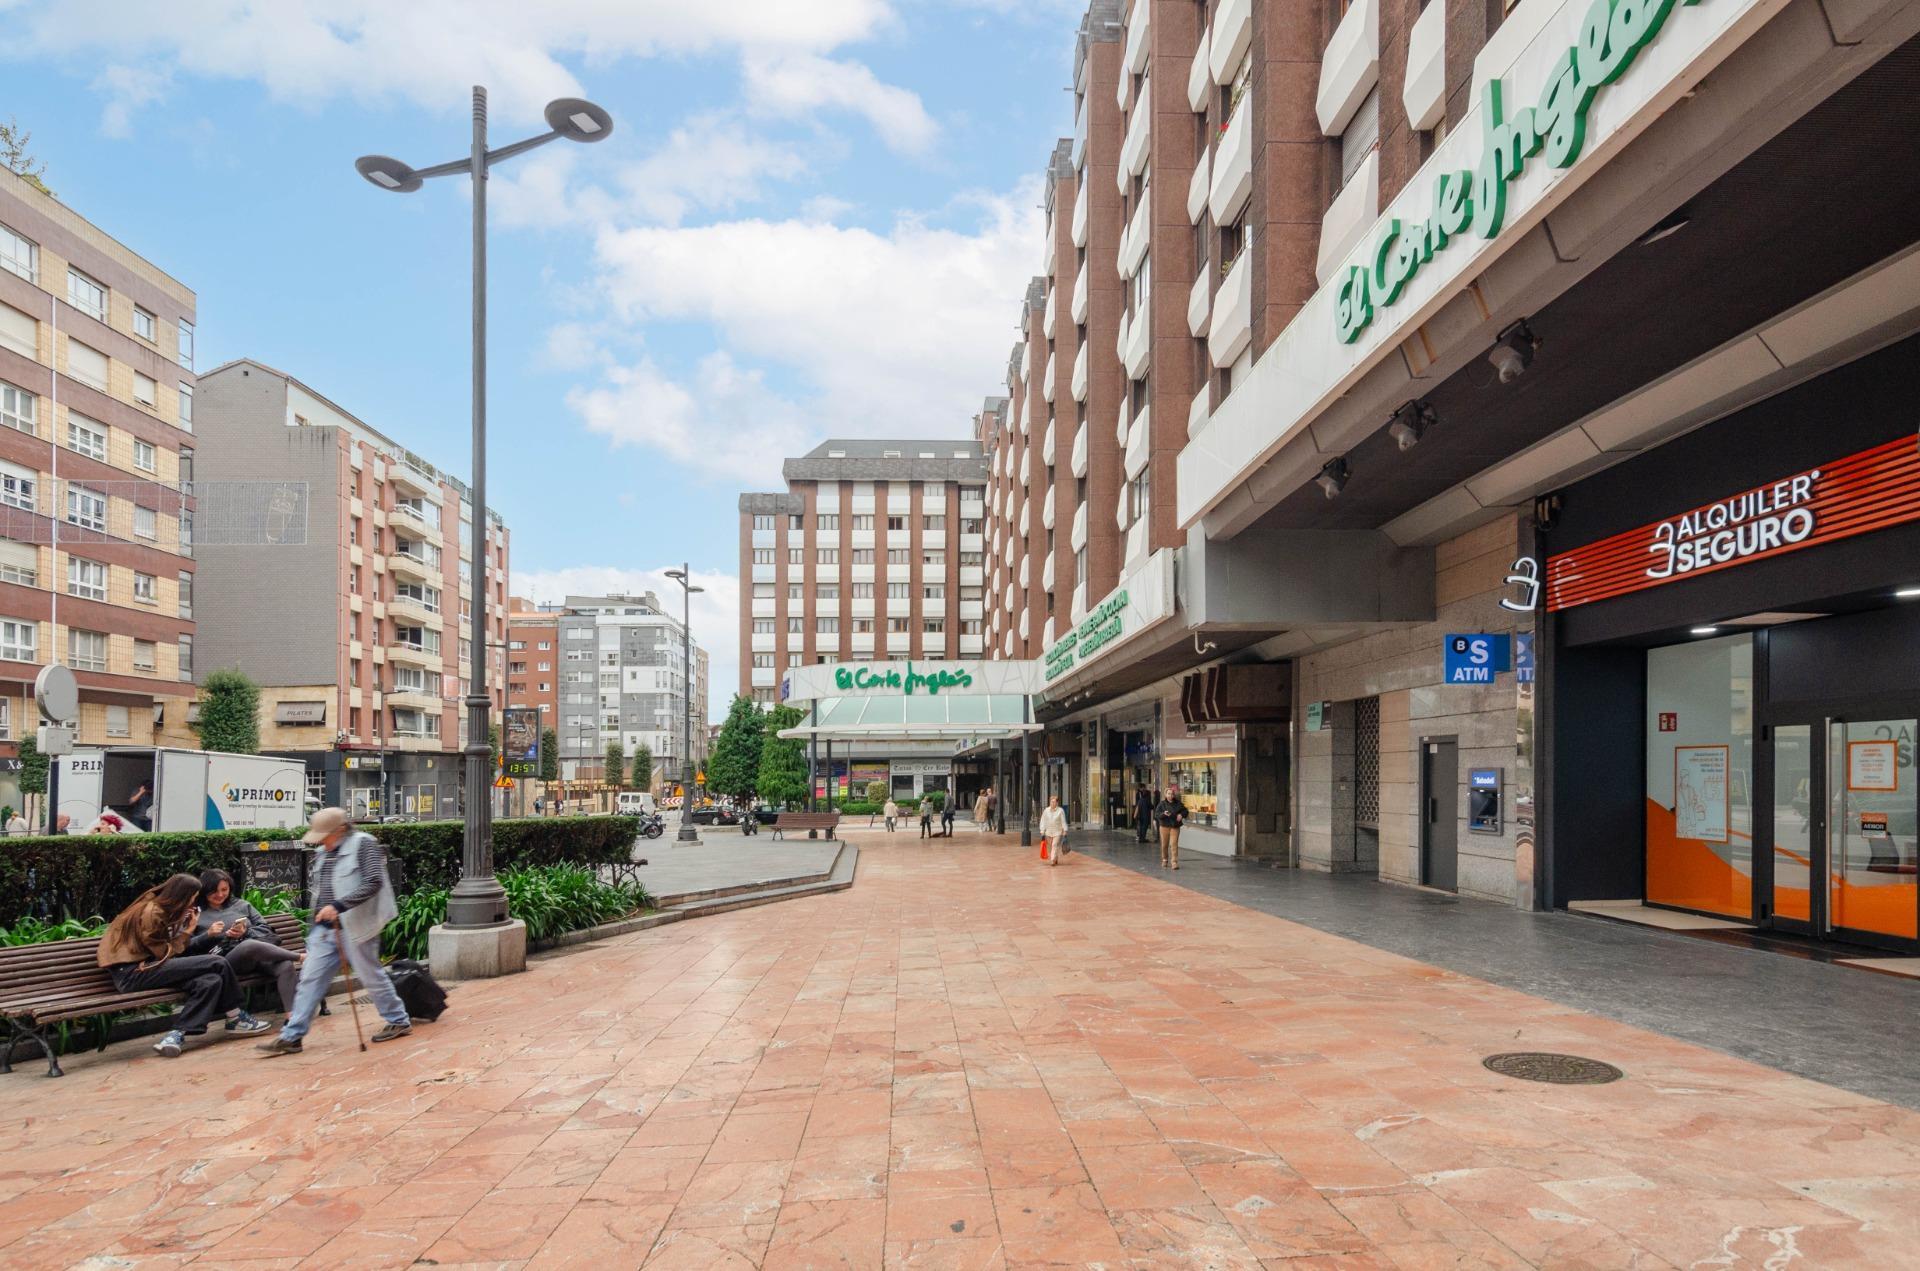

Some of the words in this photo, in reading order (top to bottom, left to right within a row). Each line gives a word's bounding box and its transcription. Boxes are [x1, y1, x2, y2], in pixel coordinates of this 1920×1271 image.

[1334, 265, 1374, 345] El
[1369, 170, 1473, 306] Corte
[1677, 475, 1811, 540] ALQUILER
[1676, 507, 1813, 573] SEGURO
[835, 667, 853, 690] El
[855, 667, 901, 689] Corte
[904, 660, 972, 696] Inglés
[1453, 667, 1488, 681] ATM
[510, 763, 536, 773] 13:57
[241, 788, 296, 802] PRIMOTI
